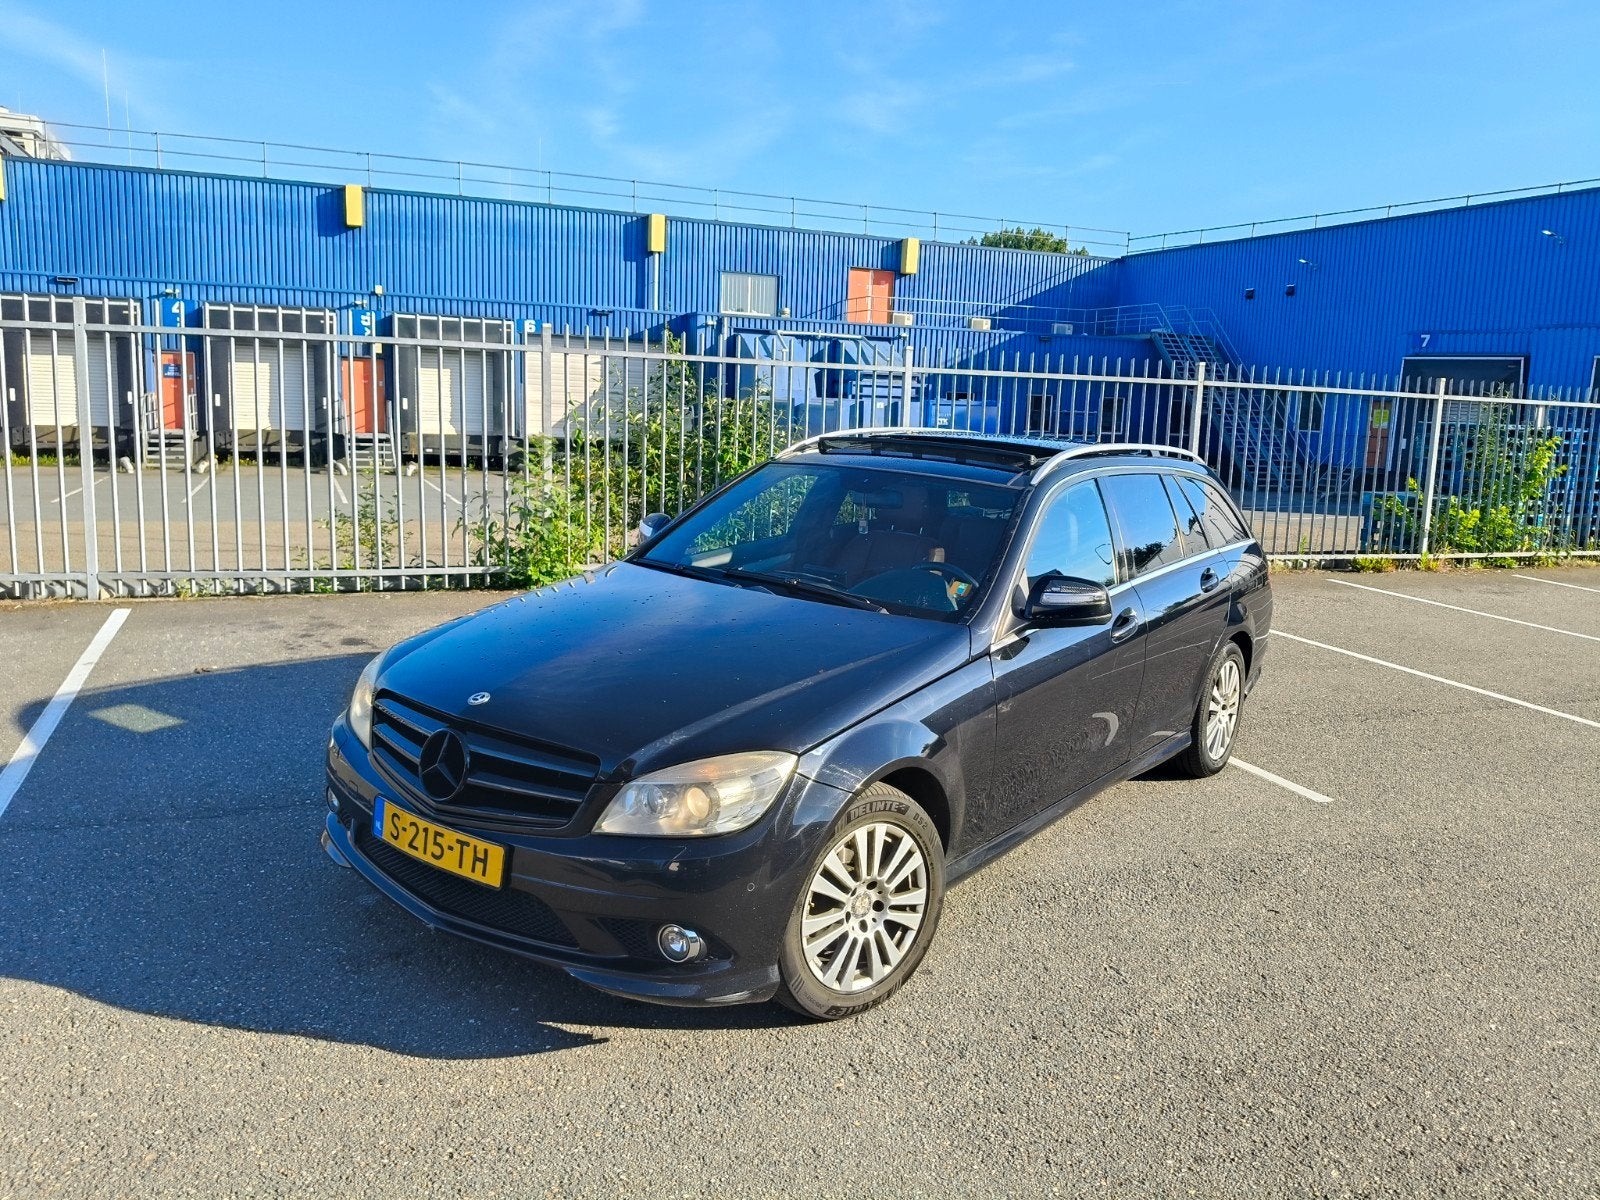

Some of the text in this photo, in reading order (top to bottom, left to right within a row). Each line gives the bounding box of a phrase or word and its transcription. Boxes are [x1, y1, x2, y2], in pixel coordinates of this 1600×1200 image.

[524, 319, 536, 333] 6
[1420, 334, 1431, 348] 7
[849, 799, 899, 820] DELINTE
[390, 812, 489, 877] S-215-TH
